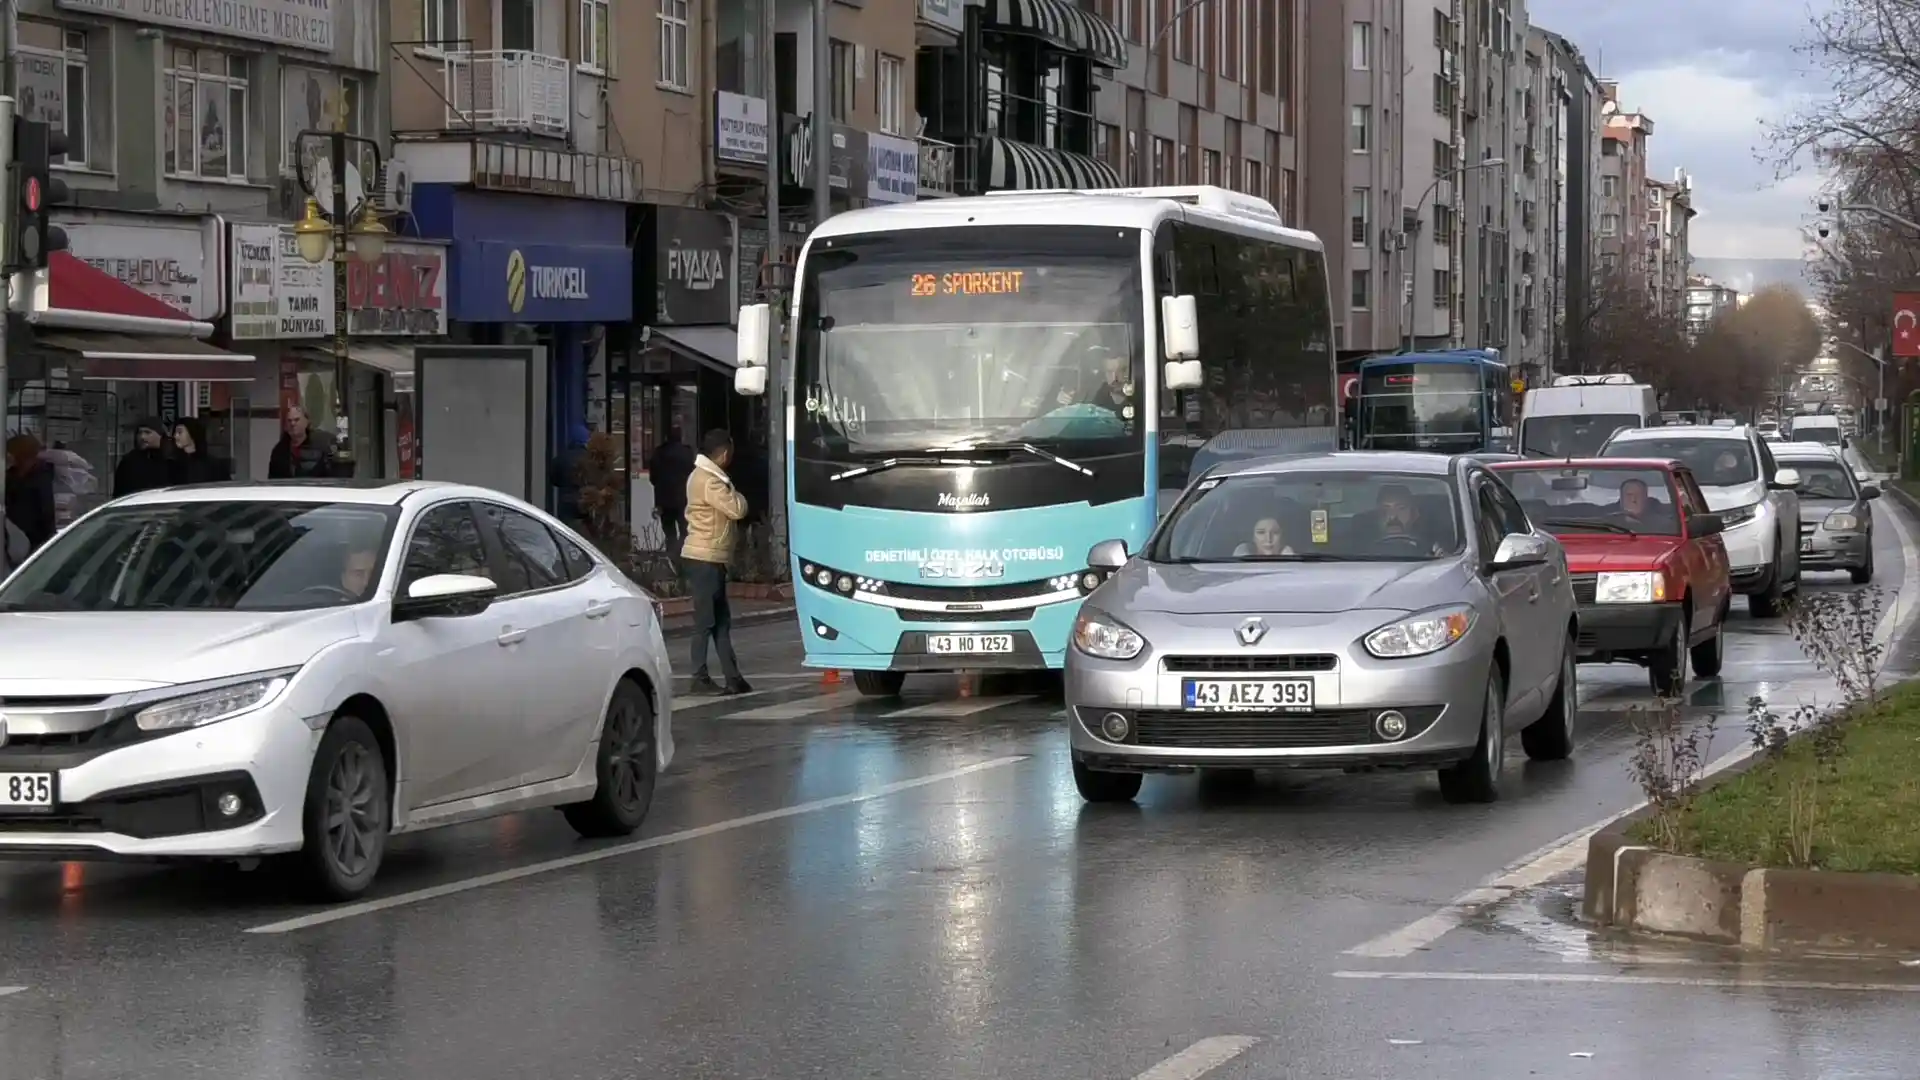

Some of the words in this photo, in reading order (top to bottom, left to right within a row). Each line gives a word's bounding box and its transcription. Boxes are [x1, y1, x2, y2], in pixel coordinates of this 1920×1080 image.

[529, 265, 589, 299] TURKCELL
[911, 273, 936, 296] 26
[942, 271, 1023, 296] SPORKENT
[864, 547, 928, 563] DENETİMLİ
[930, 547, 962, 562] ÖZEL
[964, 548, 999, 562] HALK
[1002, 545, 1064, 562] OTOBÜSÜ
[937, 637, 952, 651] 43
[981, 636, 1009, 651] 1252
[1196, 683, 1220, 704] 43
[1228, 683, 1265, 703] AEZ
[1272, 683, 1309, 703] 393
[8, 775, 49, 802] 835
